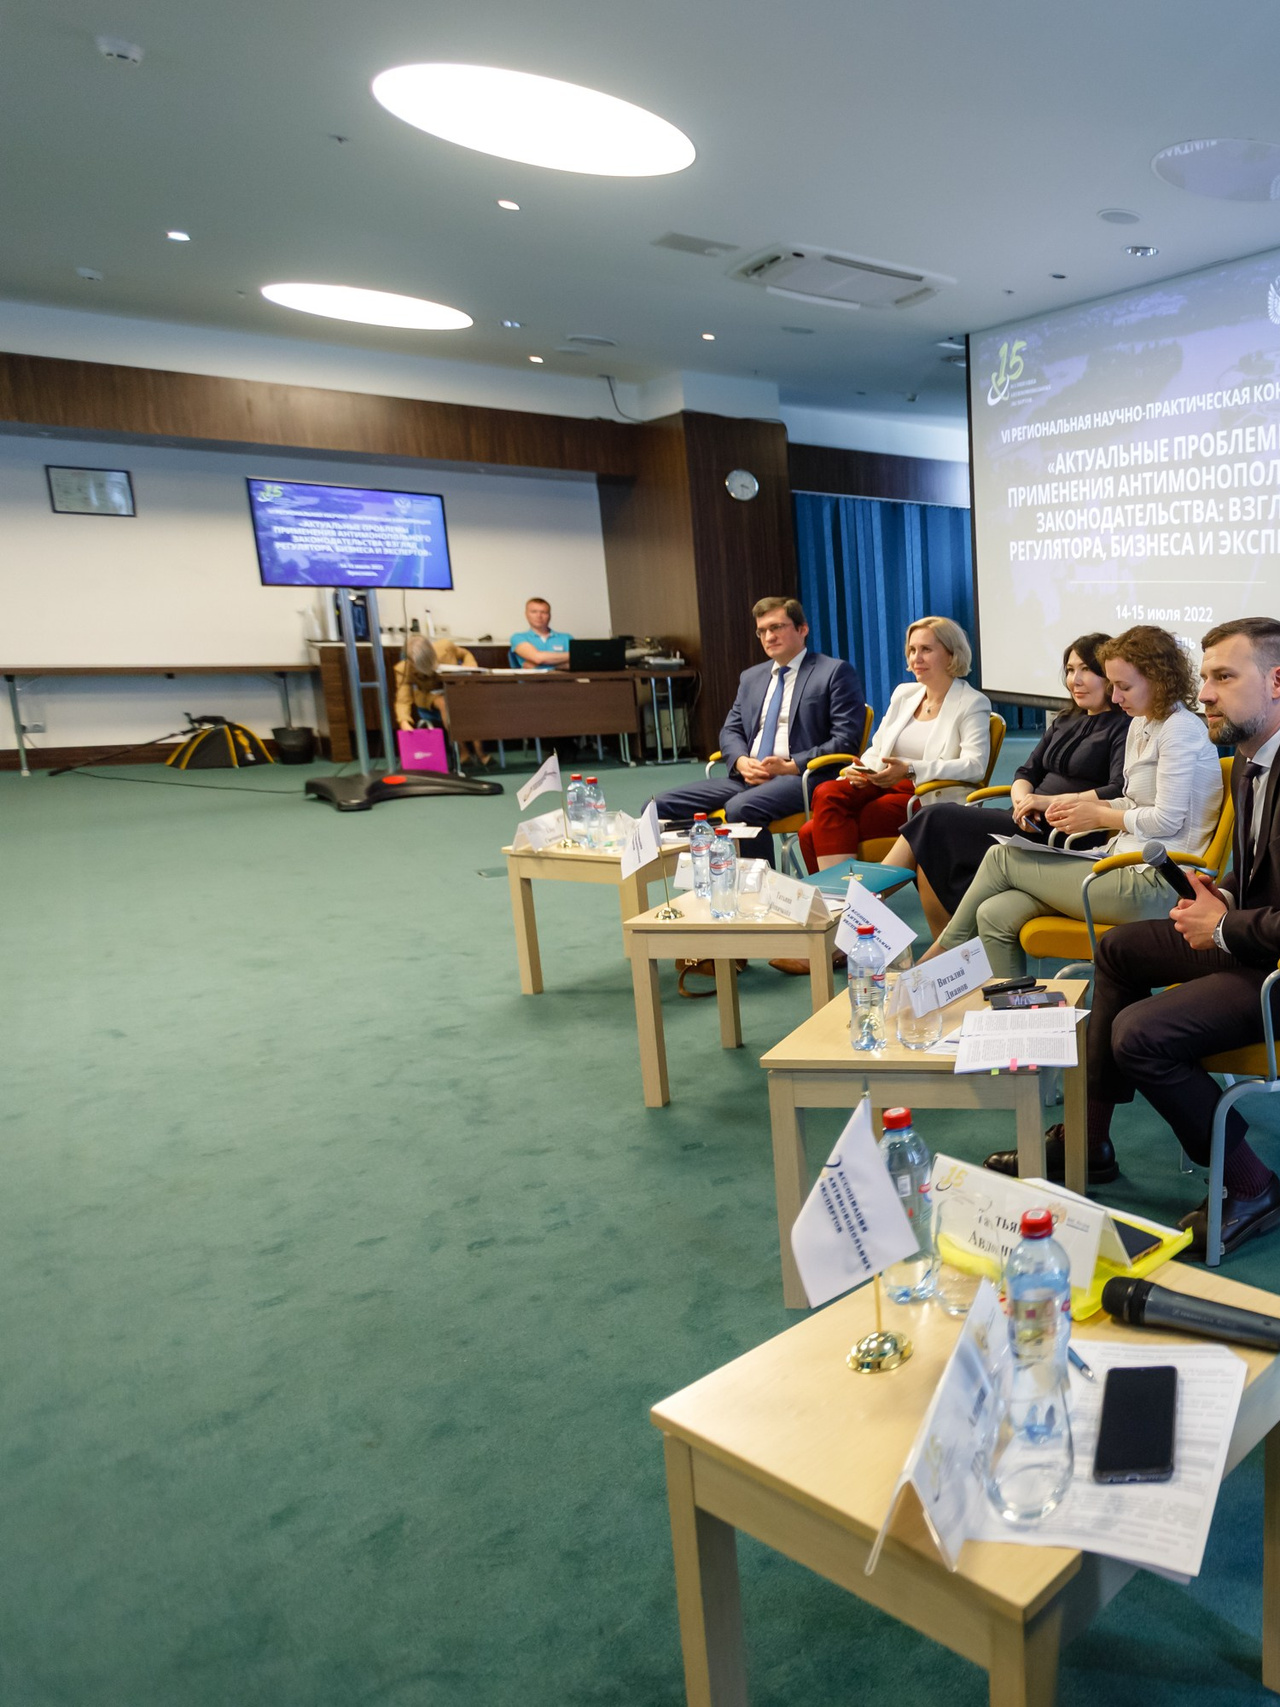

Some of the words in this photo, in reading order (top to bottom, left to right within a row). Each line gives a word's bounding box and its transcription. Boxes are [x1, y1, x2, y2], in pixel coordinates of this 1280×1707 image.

[1001, 429, 1011, 444] VI
[1011, 414, 1091, 442] РЕГИОНАЛЬНАЯ
[1093, 387, 1250, 428] НАУЧНО-ПРАКТИЧЕСКАЯ
[1047, 438, 1169, 475] «АКТУАЛЬНЫЕ
[1007, 476, 1114, 508] ПРИМЕНЕНИЯ
[1036, 498, 1224, 534] ЗАКОНОДАТЕЛЬСТВА:
[1009, 536, 1107, 561] РЕГУЛЯТОРА,
[1111, 532, 1195, 558] БИЗНЕСА
[1199, 530, 1213, 556] И
[1115, 605, 1145, 620] 14-15
[1147, 608, 1181, 621] июля
[1183, 606, 1213, 622] 2022
[937, 967, 965, 988] Виталий
[944, 983, 969, 1001] Дианов
[820, 1181, 843, 1234] ЭКСПЕРТОВ
[837, 1171, 869, 1233] АССОЦИАЦИЯ
[828, 1176, 872, 1272] АНТИМОНОПОЛЬНЫХ
